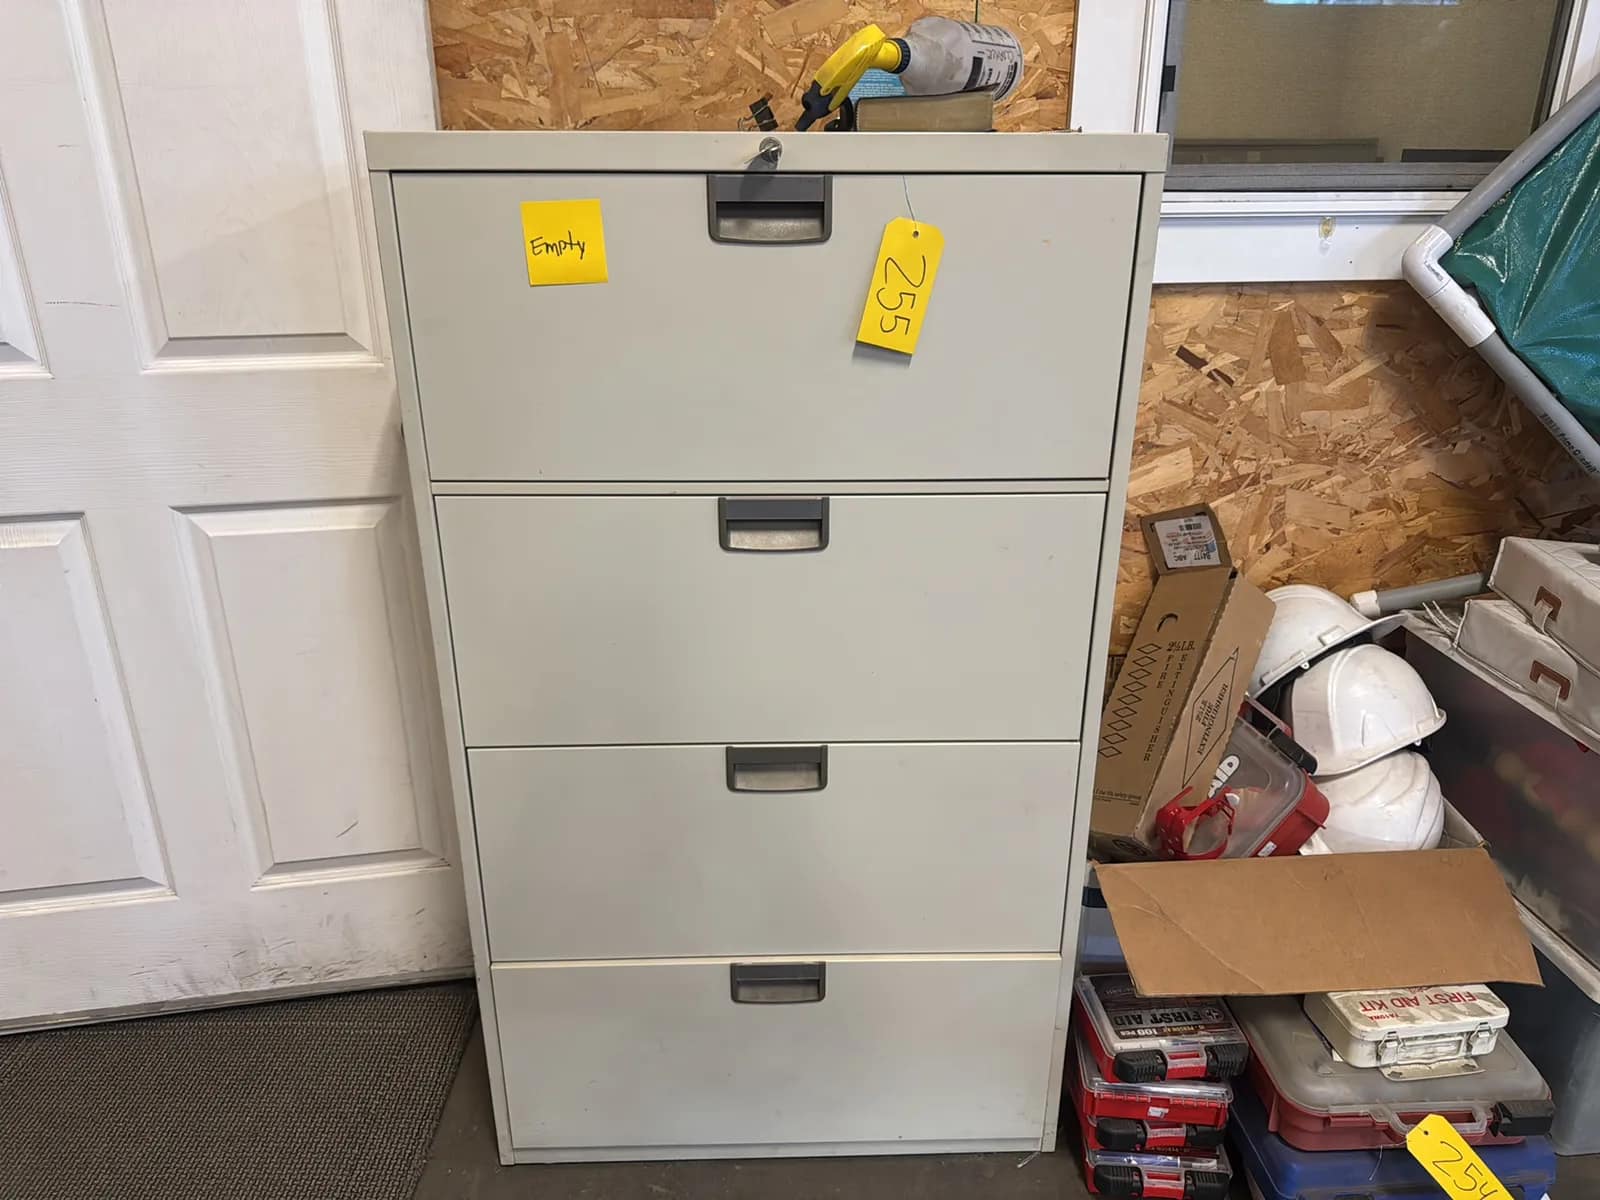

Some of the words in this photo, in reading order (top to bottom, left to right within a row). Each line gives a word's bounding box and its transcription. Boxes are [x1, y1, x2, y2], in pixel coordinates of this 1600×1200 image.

[530, 230, 586, 260] Empty
[876, 255, 926, 336] 255
[1157, 654, 1174, 689] FIRE
[1143, 653, 1188, 762] EXTINGUISHER
[1197, 683, 1229, 756] EXTINGUISHER
[1201, 702, 1214, 726] FIRE
[1358, 999, 1389, 1013] KIT
[1390, 995, 1420, 1009] AID
[1424, 991, 1477, 1006] FIRST
[1114, 1014, 1142, 1027] AID
[1150, 1010, 1202, 1025] FIRST
[1136, 1028, 1158, 1036] 100
[1432, 1140, 1499, 1200] 254
